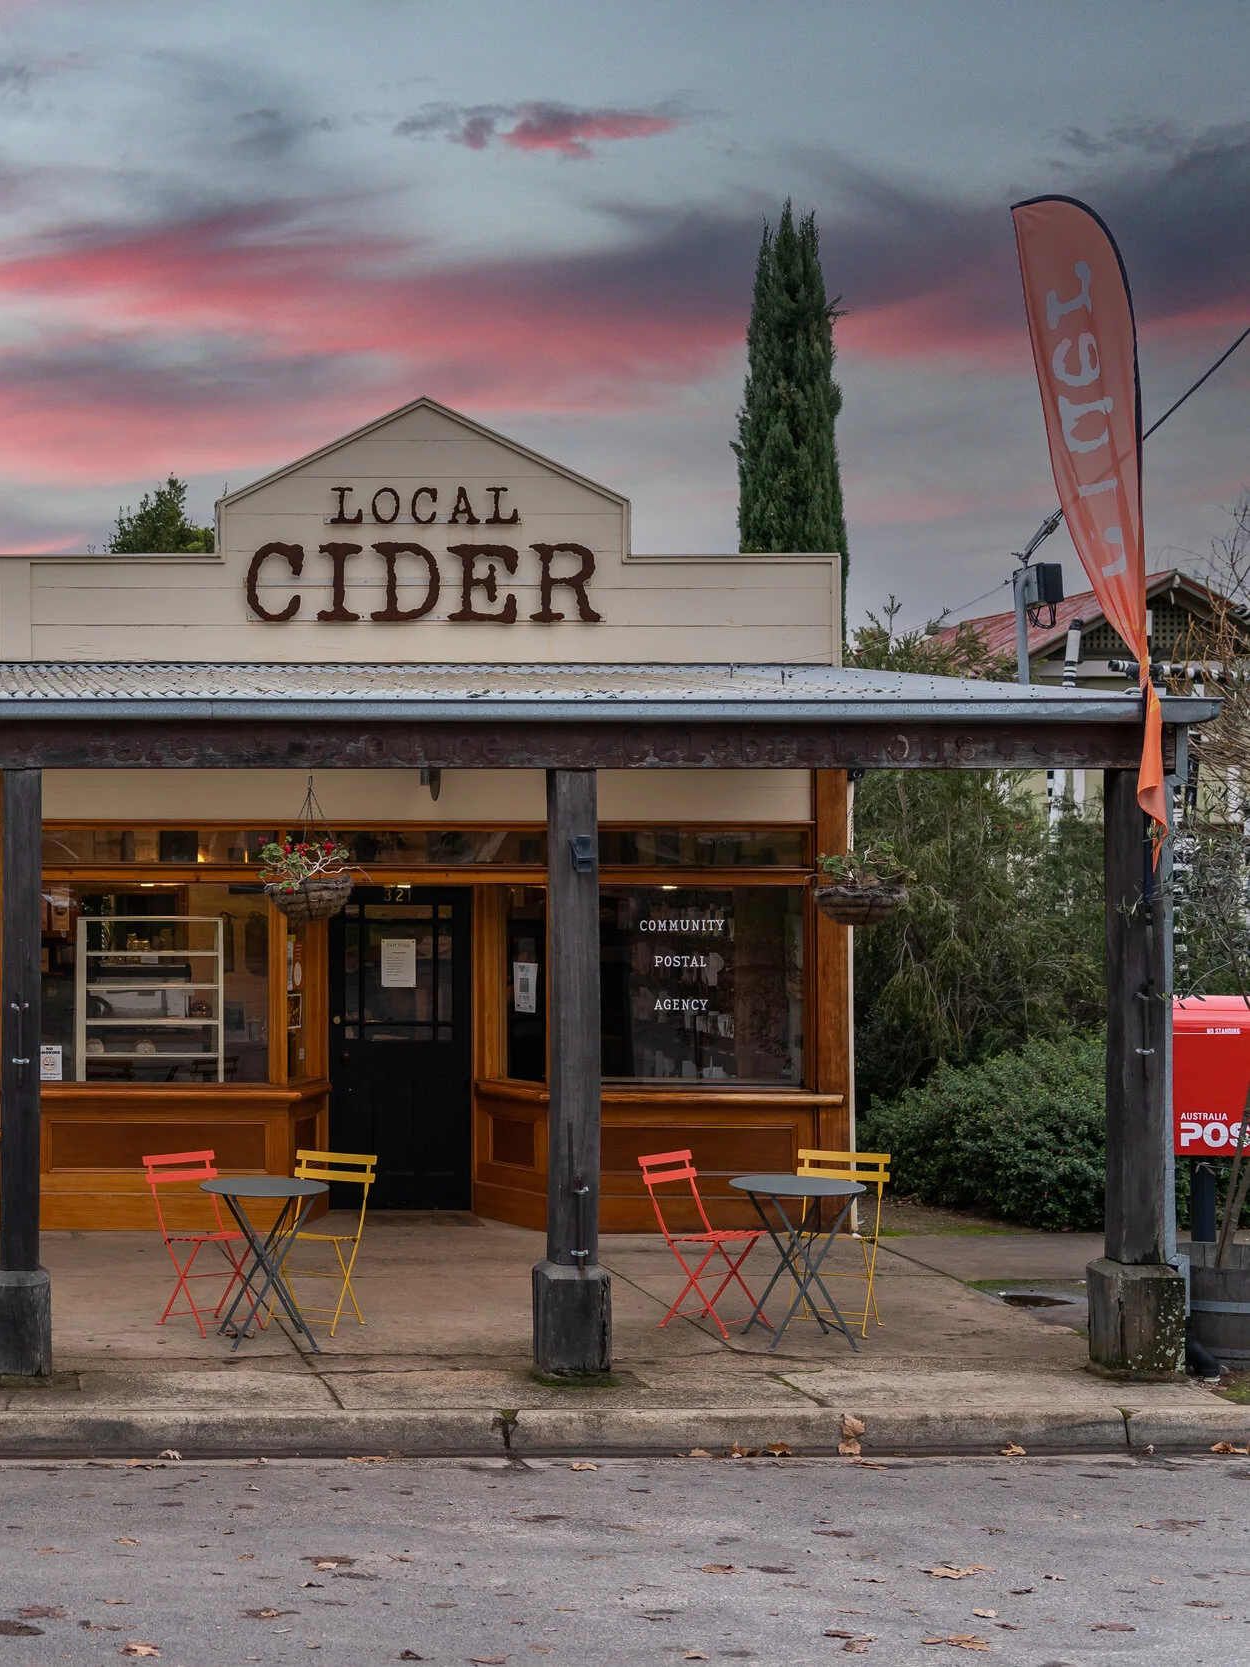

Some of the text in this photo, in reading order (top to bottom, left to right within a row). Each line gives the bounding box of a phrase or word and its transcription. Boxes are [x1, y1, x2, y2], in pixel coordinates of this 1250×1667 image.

[330, 486, 521, 526] LOCAL
[245, 541, 603, 625] CIDER
[639, 919, 725, 932] COMMUNITY
[654, 955, 707, 968] POSTAL
[653, 998, 709, 1011] AGENCY
[1180, 1112, 1228, 1121] AUSTRALIA
